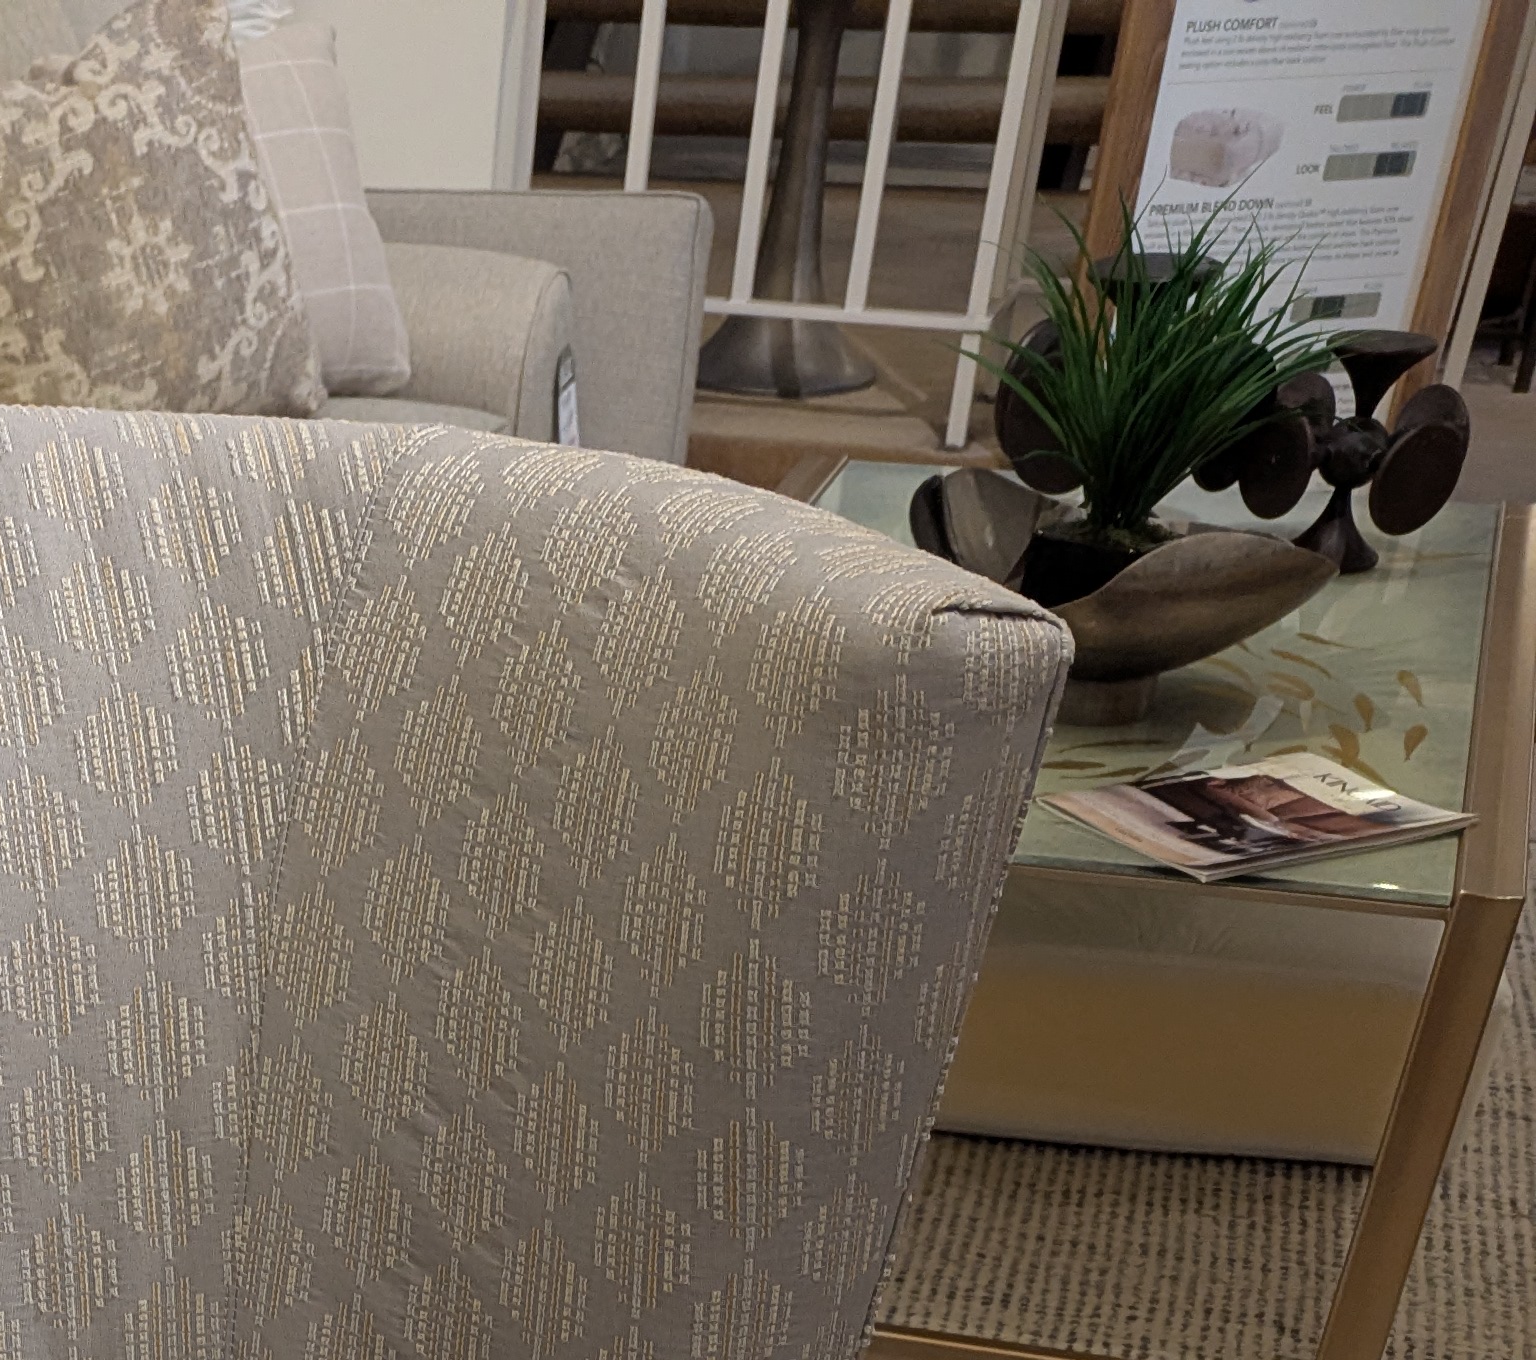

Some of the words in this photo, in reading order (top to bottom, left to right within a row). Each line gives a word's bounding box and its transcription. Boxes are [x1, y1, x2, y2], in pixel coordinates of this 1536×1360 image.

[1186, 19, 1221, 33] PLUSH
[1224, 17, 1279, 31] COMFORT
[1149, 202, 1199, 216] PREMIUM
[1239, 198, 1274, 211] DOWN
